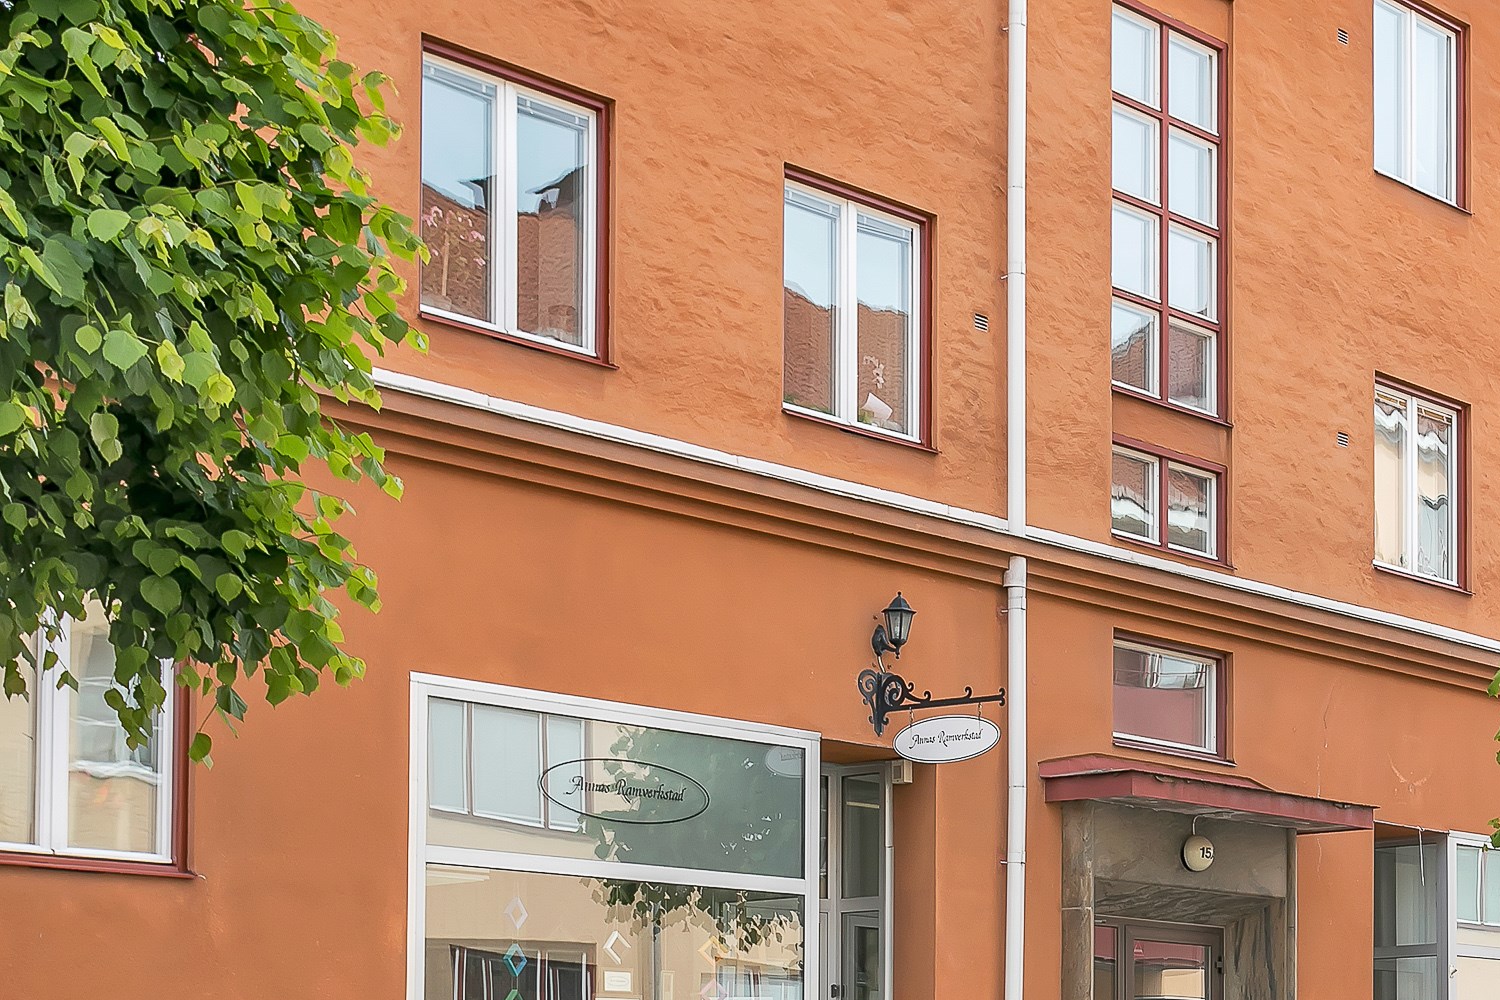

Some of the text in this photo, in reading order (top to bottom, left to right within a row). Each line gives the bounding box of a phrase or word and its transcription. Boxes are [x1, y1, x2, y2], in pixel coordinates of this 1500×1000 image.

[908, 728, 984, 750] Annas Ramverkstad
[563, 775, 687, 804] Annas Ramverkstad
